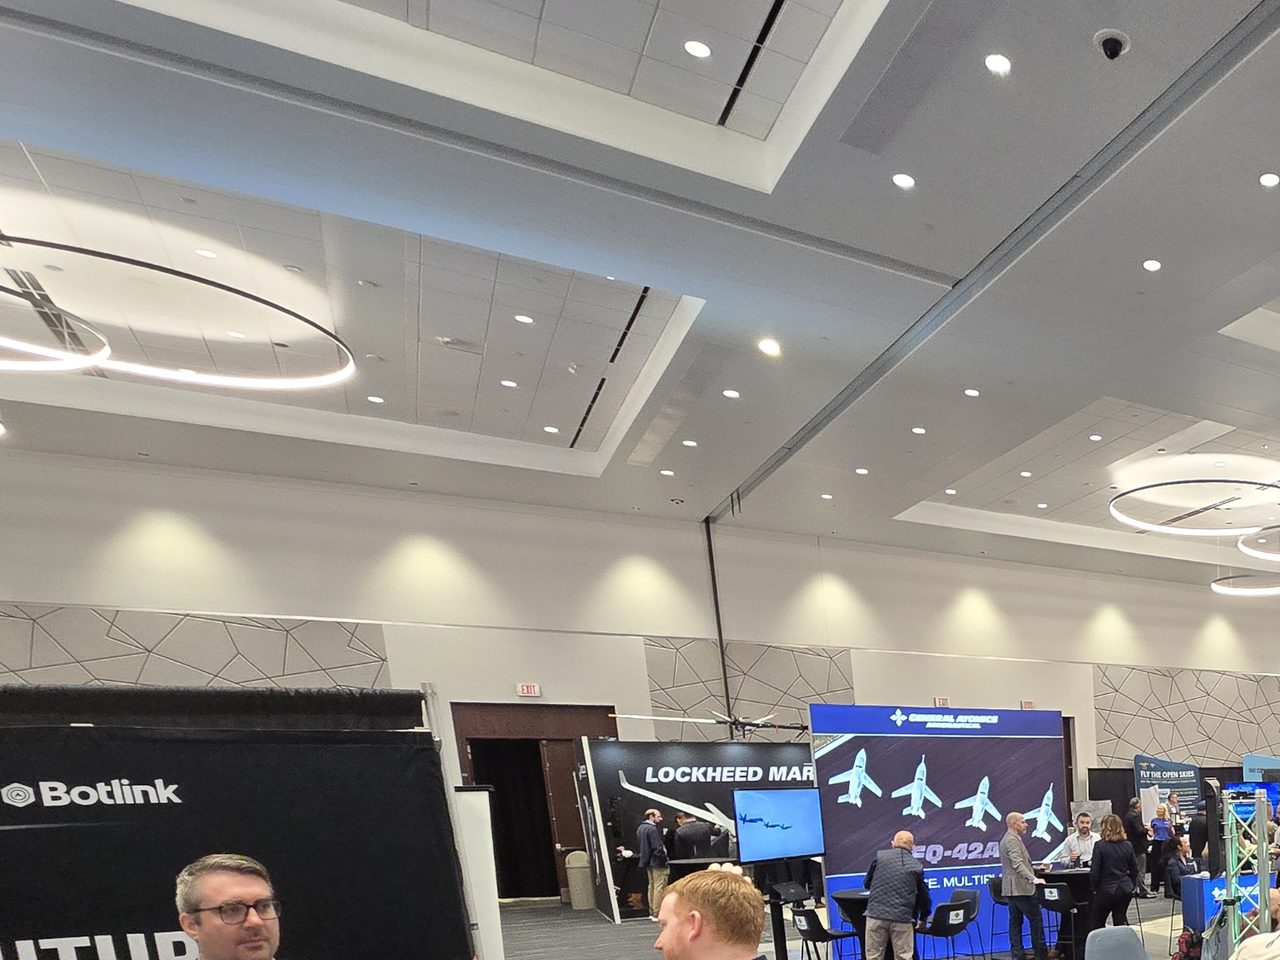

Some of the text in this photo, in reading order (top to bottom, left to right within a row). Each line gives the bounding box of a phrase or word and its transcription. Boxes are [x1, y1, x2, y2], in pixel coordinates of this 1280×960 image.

[521, 684, 536, 695] EXIT
[645, 766, 814, 783] LOCKHEED MAR
[1140, 770, 1150, 778] FLY
[38, 778, 183, 807] Botlink
[943, 874, 996, 888] MULTIP
